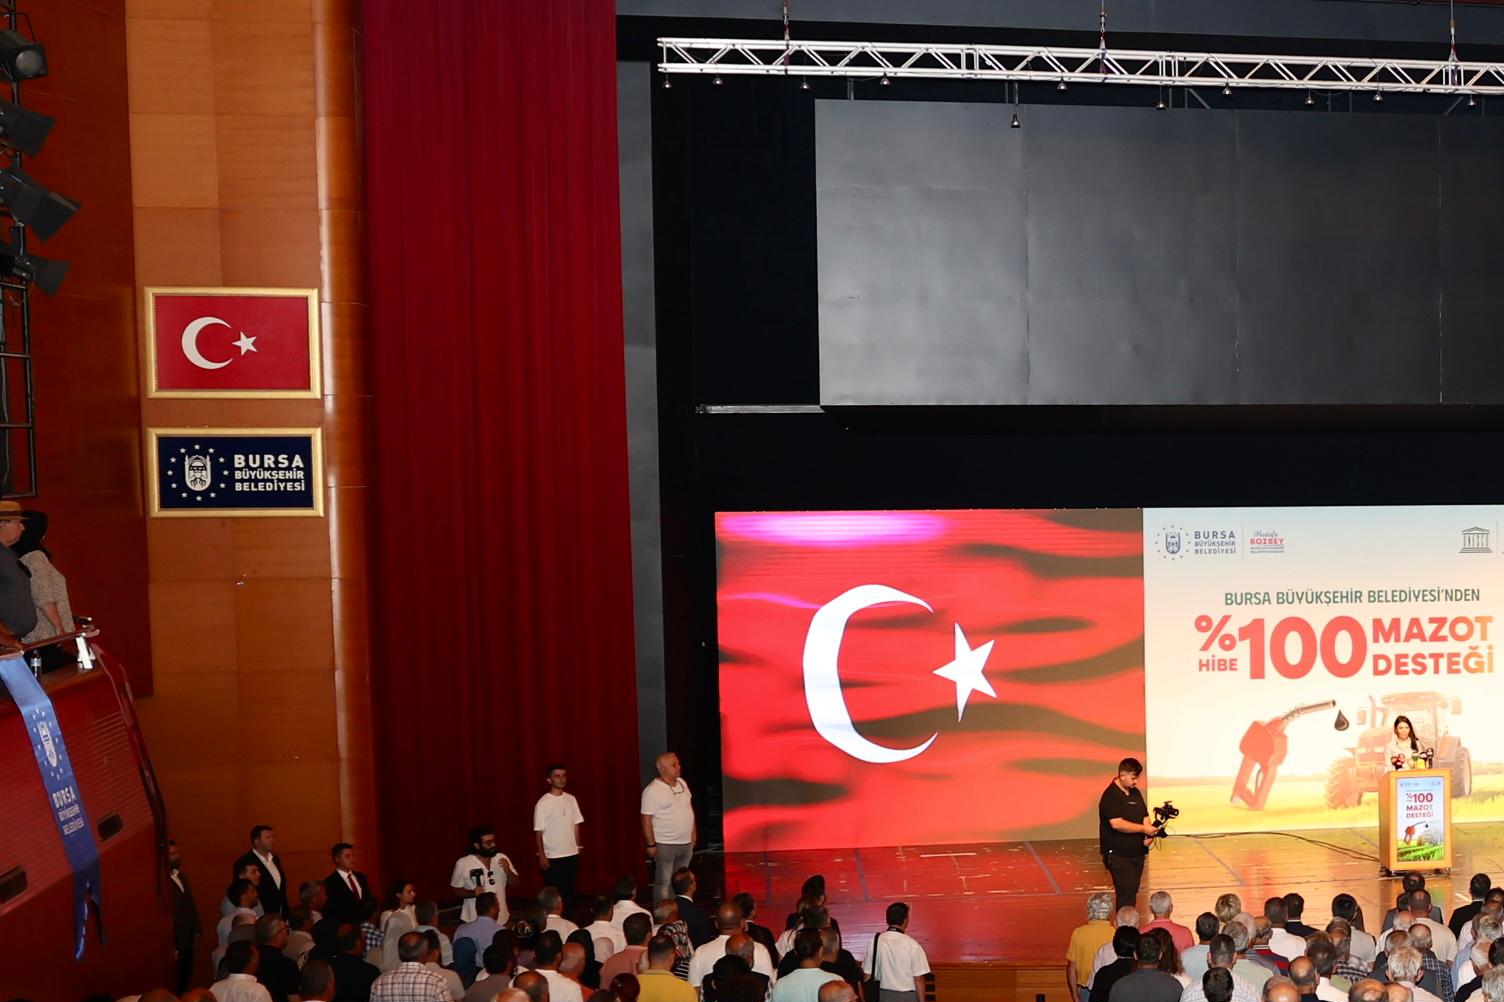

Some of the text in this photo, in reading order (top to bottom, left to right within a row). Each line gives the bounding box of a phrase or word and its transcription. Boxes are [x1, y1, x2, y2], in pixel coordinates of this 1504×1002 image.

[234, 454, 304, 468] BURSA
[234, 468, 304, 480] BÜYÜKŞEHİR
[235, 480, 305, 491] BELEDİYESİ
[1194, 530, 1236, 540] BURSA
[1249, 537, 1285, 545] BOZBEY
[1194, 547, 1237, 555] BELEDİYESİ
[1224, 587, 1480, 607] BURSA BÜYÜKŞEHİR BELEDİYESİ'NDEN
[1372, 615, 1494, 643] MAZOT
[1198, 644, 1494, 676] HİBE DESTEĞİ
